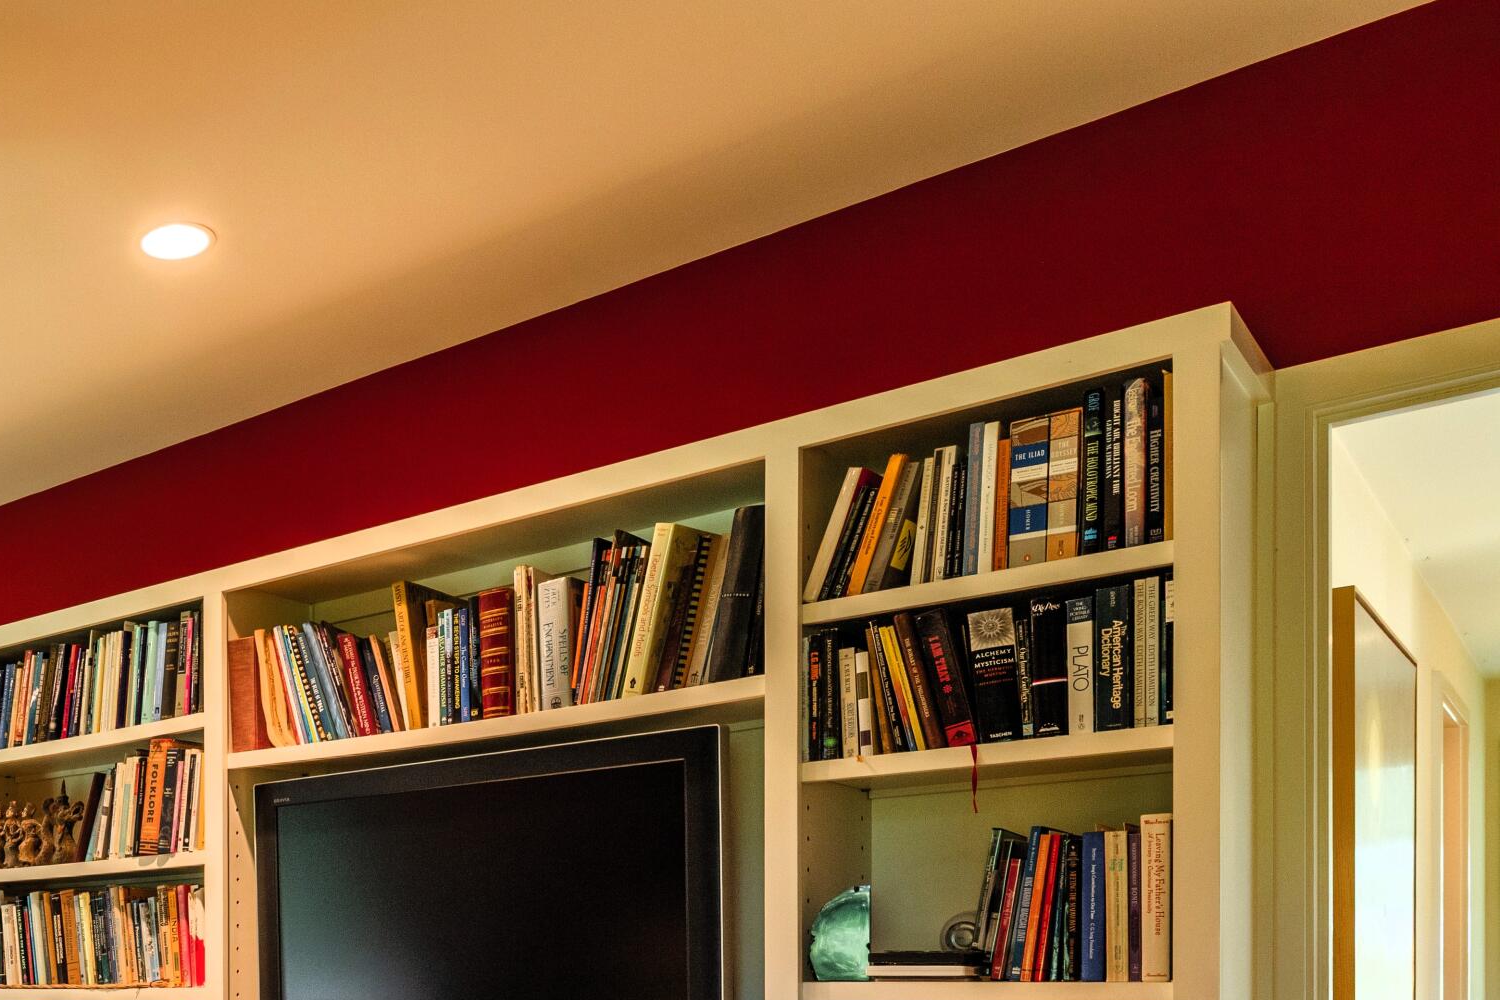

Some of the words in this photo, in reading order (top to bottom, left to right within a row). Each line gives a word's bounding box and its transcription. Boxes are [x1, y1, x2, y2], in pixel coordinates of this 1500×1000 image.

[1015, 452, 1026, 461] THE
[1028, 449, 1045, 459] ILIAD
[1087, 441, 1100, 455] THE
[649, 553, 661, 582] Tibetan
[634, 634, 646, 657] Motifs
[975, 648, 1011, 659] ALCHEMY
[1099, 628, 1112, 677] Dictionary
[1110, 620, 1122, 666] American
[974, 657, 1015, 669] MYSTICISM
[1072, 646, 1089, 692] PLATO
[1110, 668, 1123, 709] Heritage
[146, 764, 159, 824] FOLKLORE
[1152, 832, 1165, 863] Leaving
[1153, 864, 1165, 876] My
[1155, 878, 1165, 909] Father's
[1155, 911, 1165, 936] House
